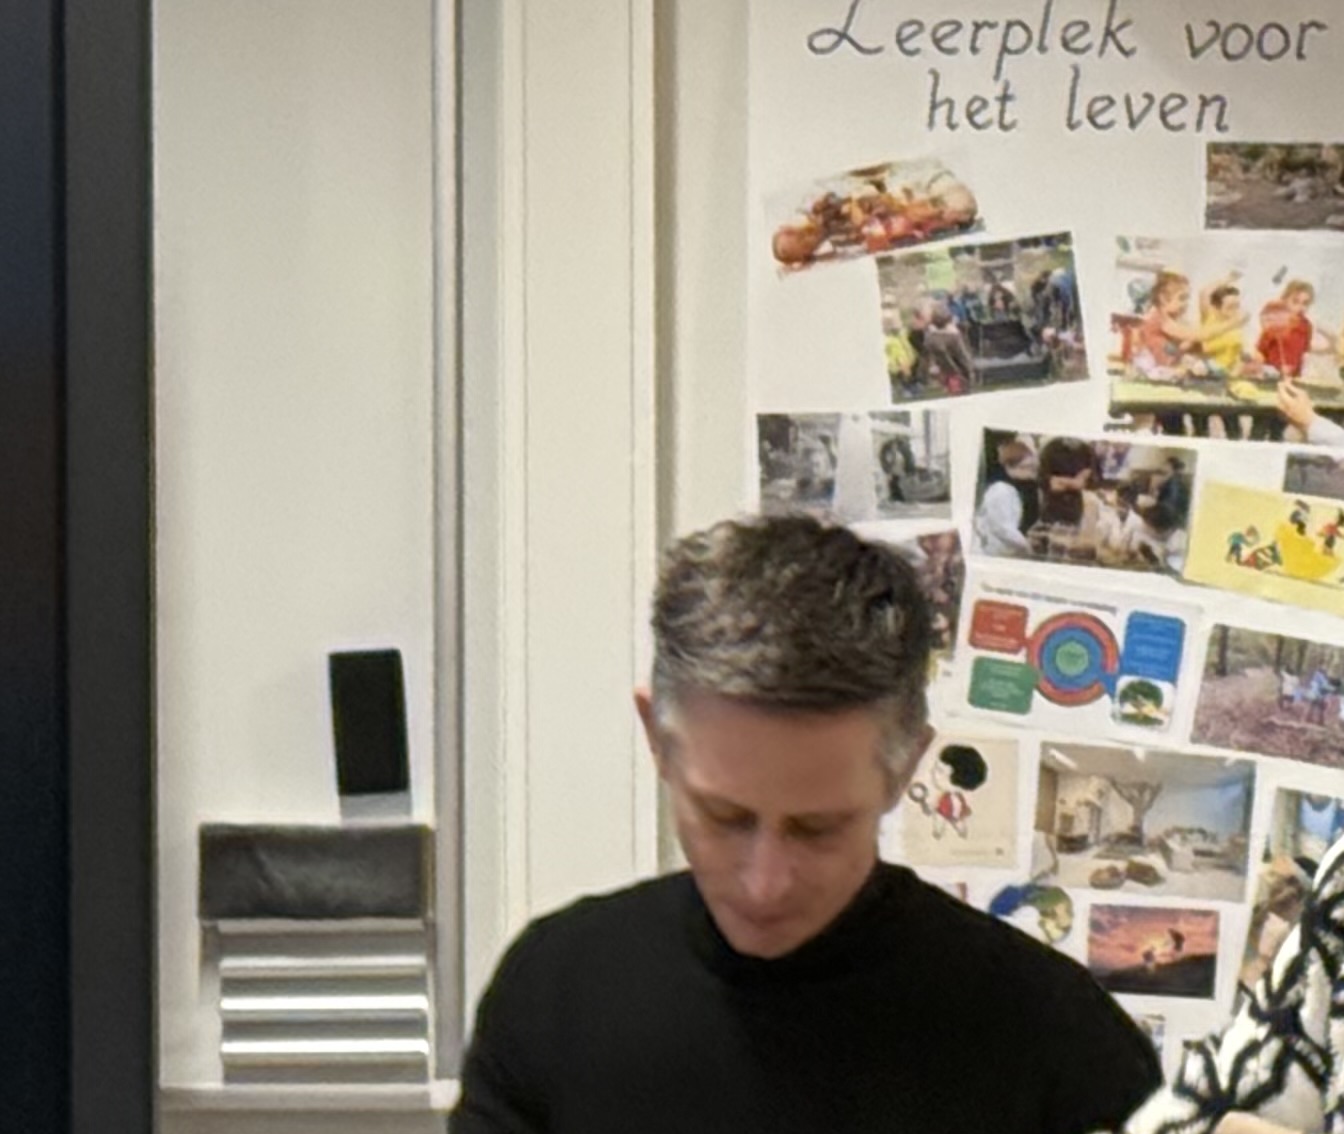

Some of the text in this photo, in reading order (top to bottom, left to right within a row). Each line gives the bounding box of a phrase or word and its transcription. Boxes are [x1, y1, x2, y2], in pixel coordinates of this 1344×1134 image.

[806, 0, 1329, 81] Leerplek voor
[926, 63, 1230, 133] het leven
